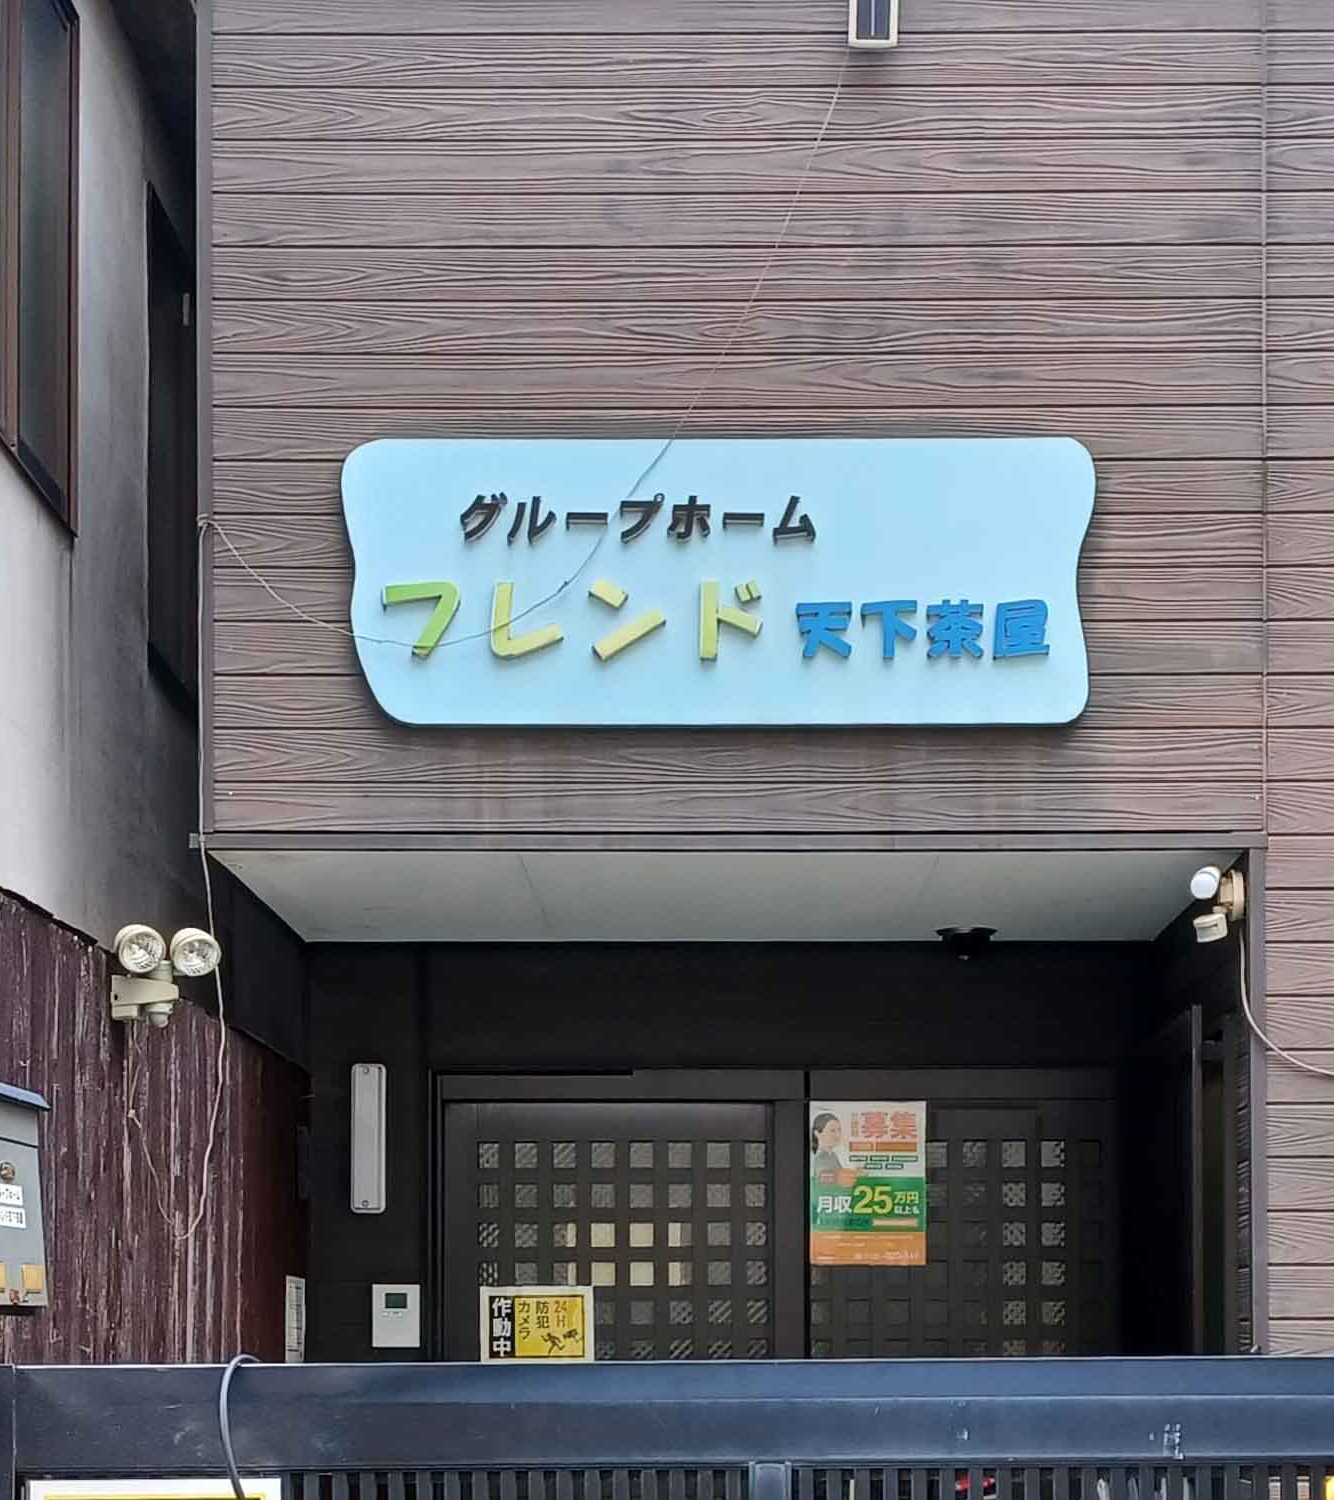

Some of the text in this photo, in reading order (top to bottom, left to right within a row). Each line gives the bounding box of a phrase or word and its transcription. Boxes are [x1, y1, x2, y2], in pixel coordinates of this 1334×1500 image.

[460, 491, 817, 546] グループホーム
[381, 577, 1051, 662] フレンド 天下茶屋
[491, 1297, 513, 1358] 作動中
[517, 1300, 532, 1340] カメラ
[535, 1300, 550, 1329] 防犯
